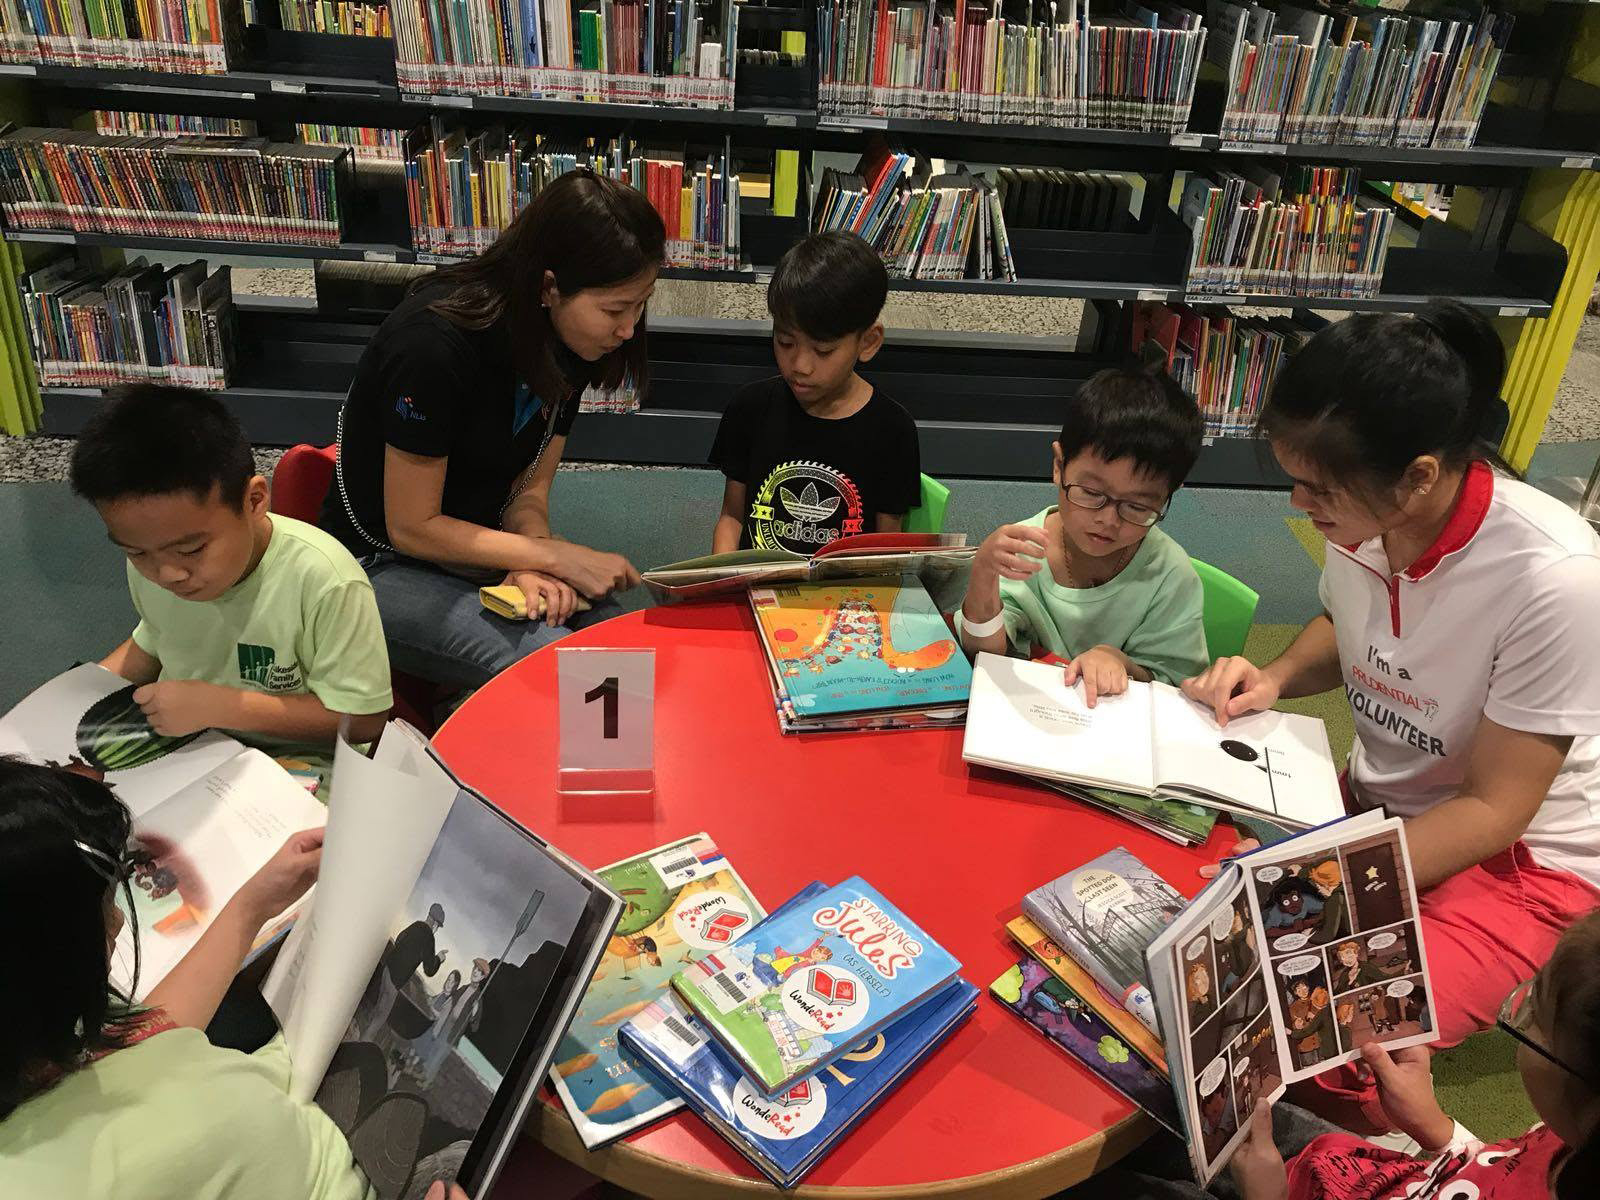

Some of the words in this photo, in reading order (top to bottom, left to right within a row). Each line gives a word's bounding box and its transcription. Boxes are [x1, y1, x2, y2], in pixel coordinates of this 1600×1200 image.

[774, 519, 839, 544] adidas
[270, 672, 295, 682] Family
[1367, 645, 1391, 675] I'm
[1398, 667, 1412, 680] a
[585, 677, 619, 739] 1
[1352, 665, 1423, 712] PRUDENTIAL
[1344, 682, 1447, 757] VOLUNTEER
[1076, 880, 1104, 897] SPOTTED
[1103, 874, 1116, 885] DOG
[1083, 874, 1097, 884] THE
[1088, 889, 1103, 901] LAST
[1102, 882, 1118, 894] SEEN
[677, 896, 728, 922] WondeRead
[853, 897, 923, 957] STARRING
[842, 953, 858, 968] (AS
[856, 966, 891, 998] HERSELF)
[789, 988, 837, 1032] WondeRead
[741, 1094, 796, 1137] WondeRead
